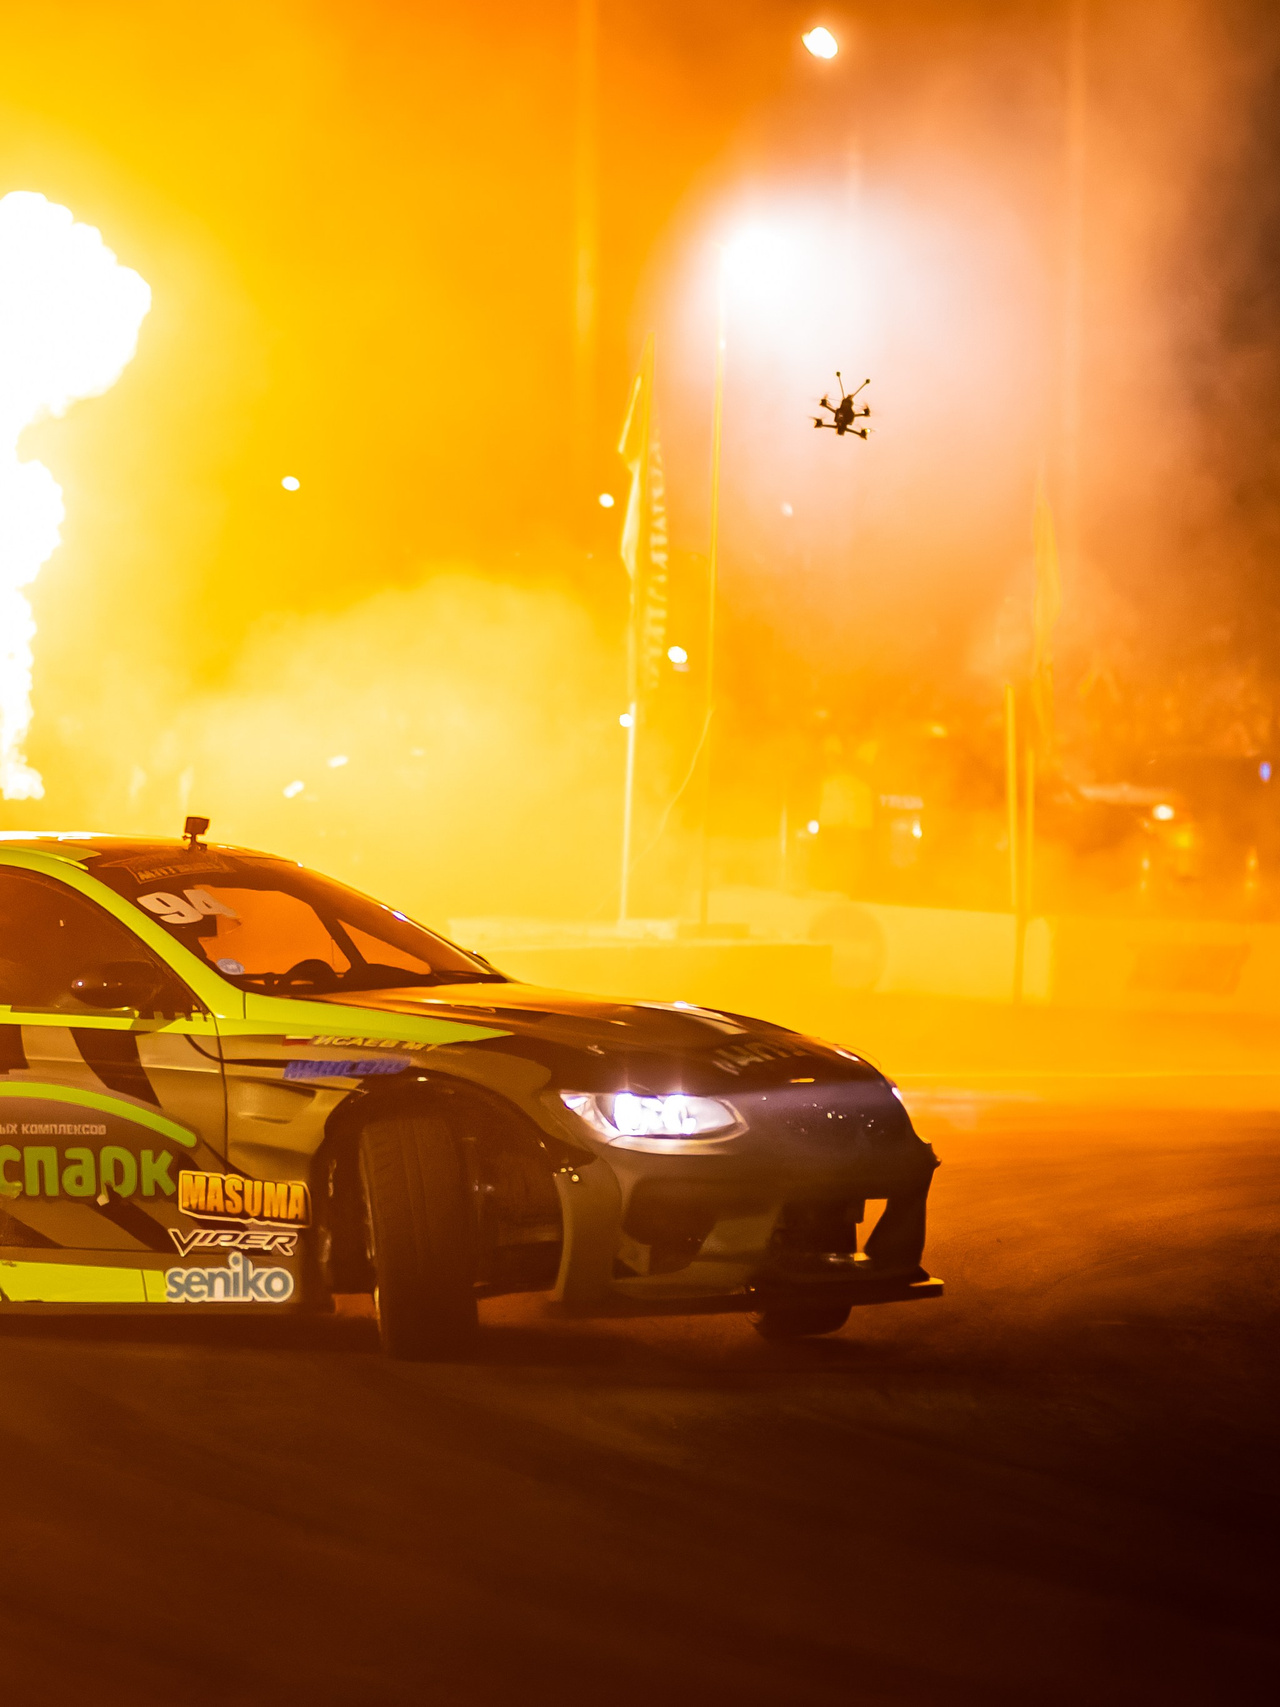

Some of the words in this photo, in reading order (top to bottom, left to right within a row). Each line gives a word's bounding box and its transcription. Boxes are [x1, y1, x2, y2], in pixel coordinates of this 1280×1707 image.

[136, 888, 237, 924] 94
[21, 1124, 107, 1136] КОМПЛЕКСОВ
[181, 1173, 307, 1221] MASUMA
[168, 1229, 298, 1257] VIPER
[166, 1251, 294, 1300] seniko
